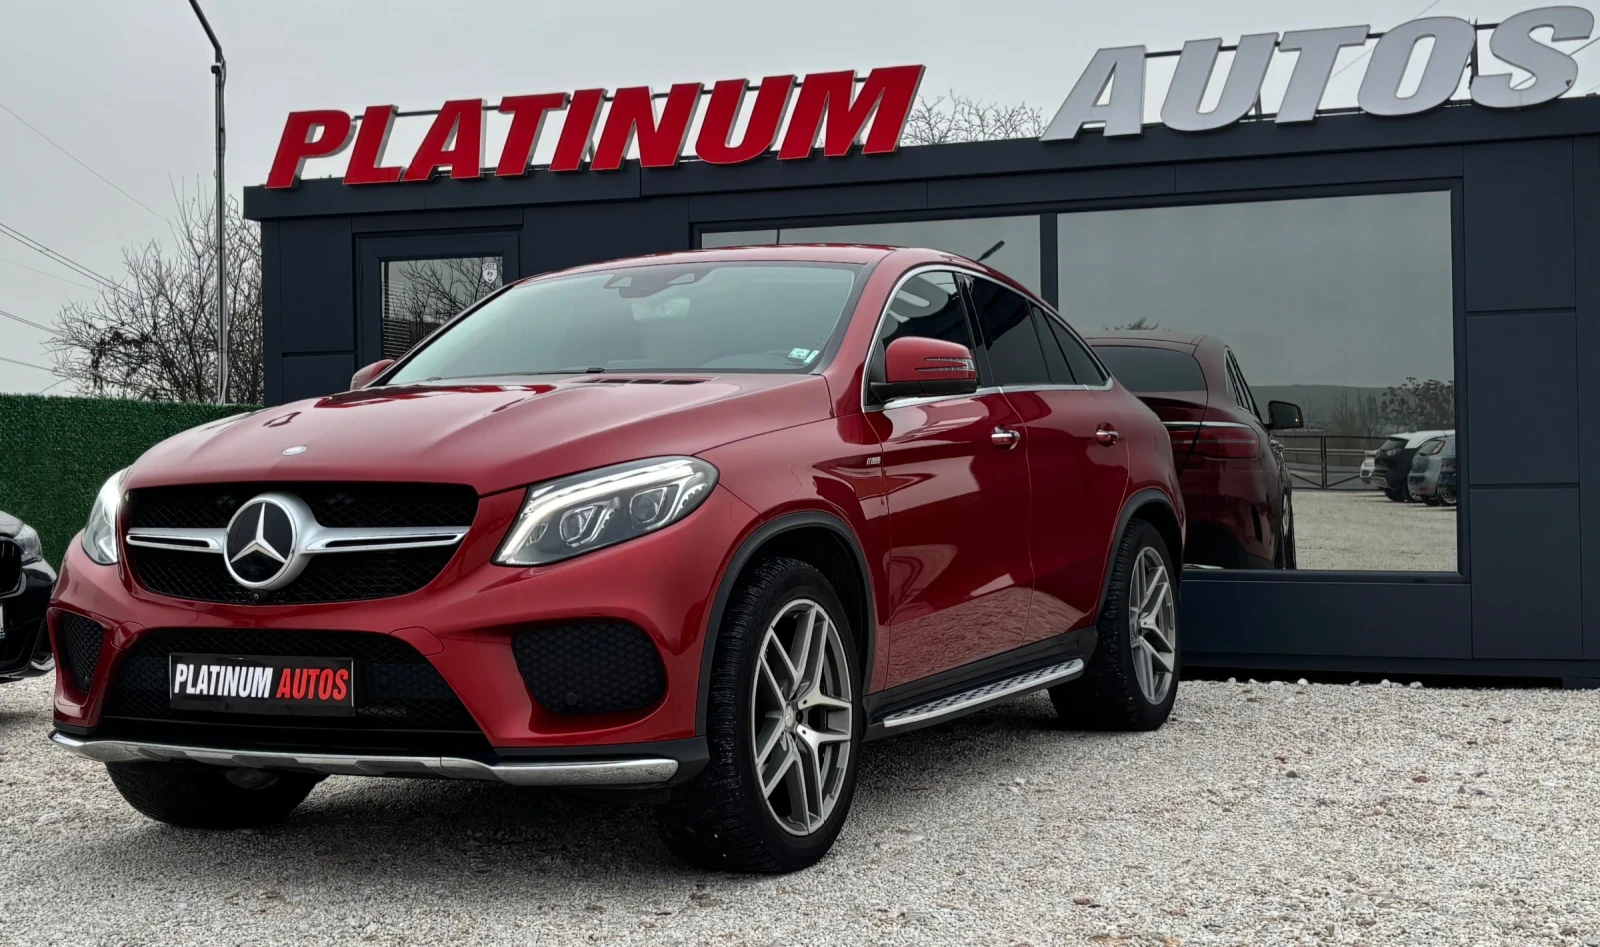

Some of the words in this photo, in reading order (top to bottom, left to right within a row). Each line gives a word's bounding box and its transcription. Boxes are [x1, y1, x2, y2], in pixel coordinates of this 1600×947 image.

[265, 64, 926, 189] PLATINUM
[1039, 6, 1595, 142] AUTOS
[174, 663, 273, 698] PLATINUM
[276, 668, 349, 700] AUTOS
